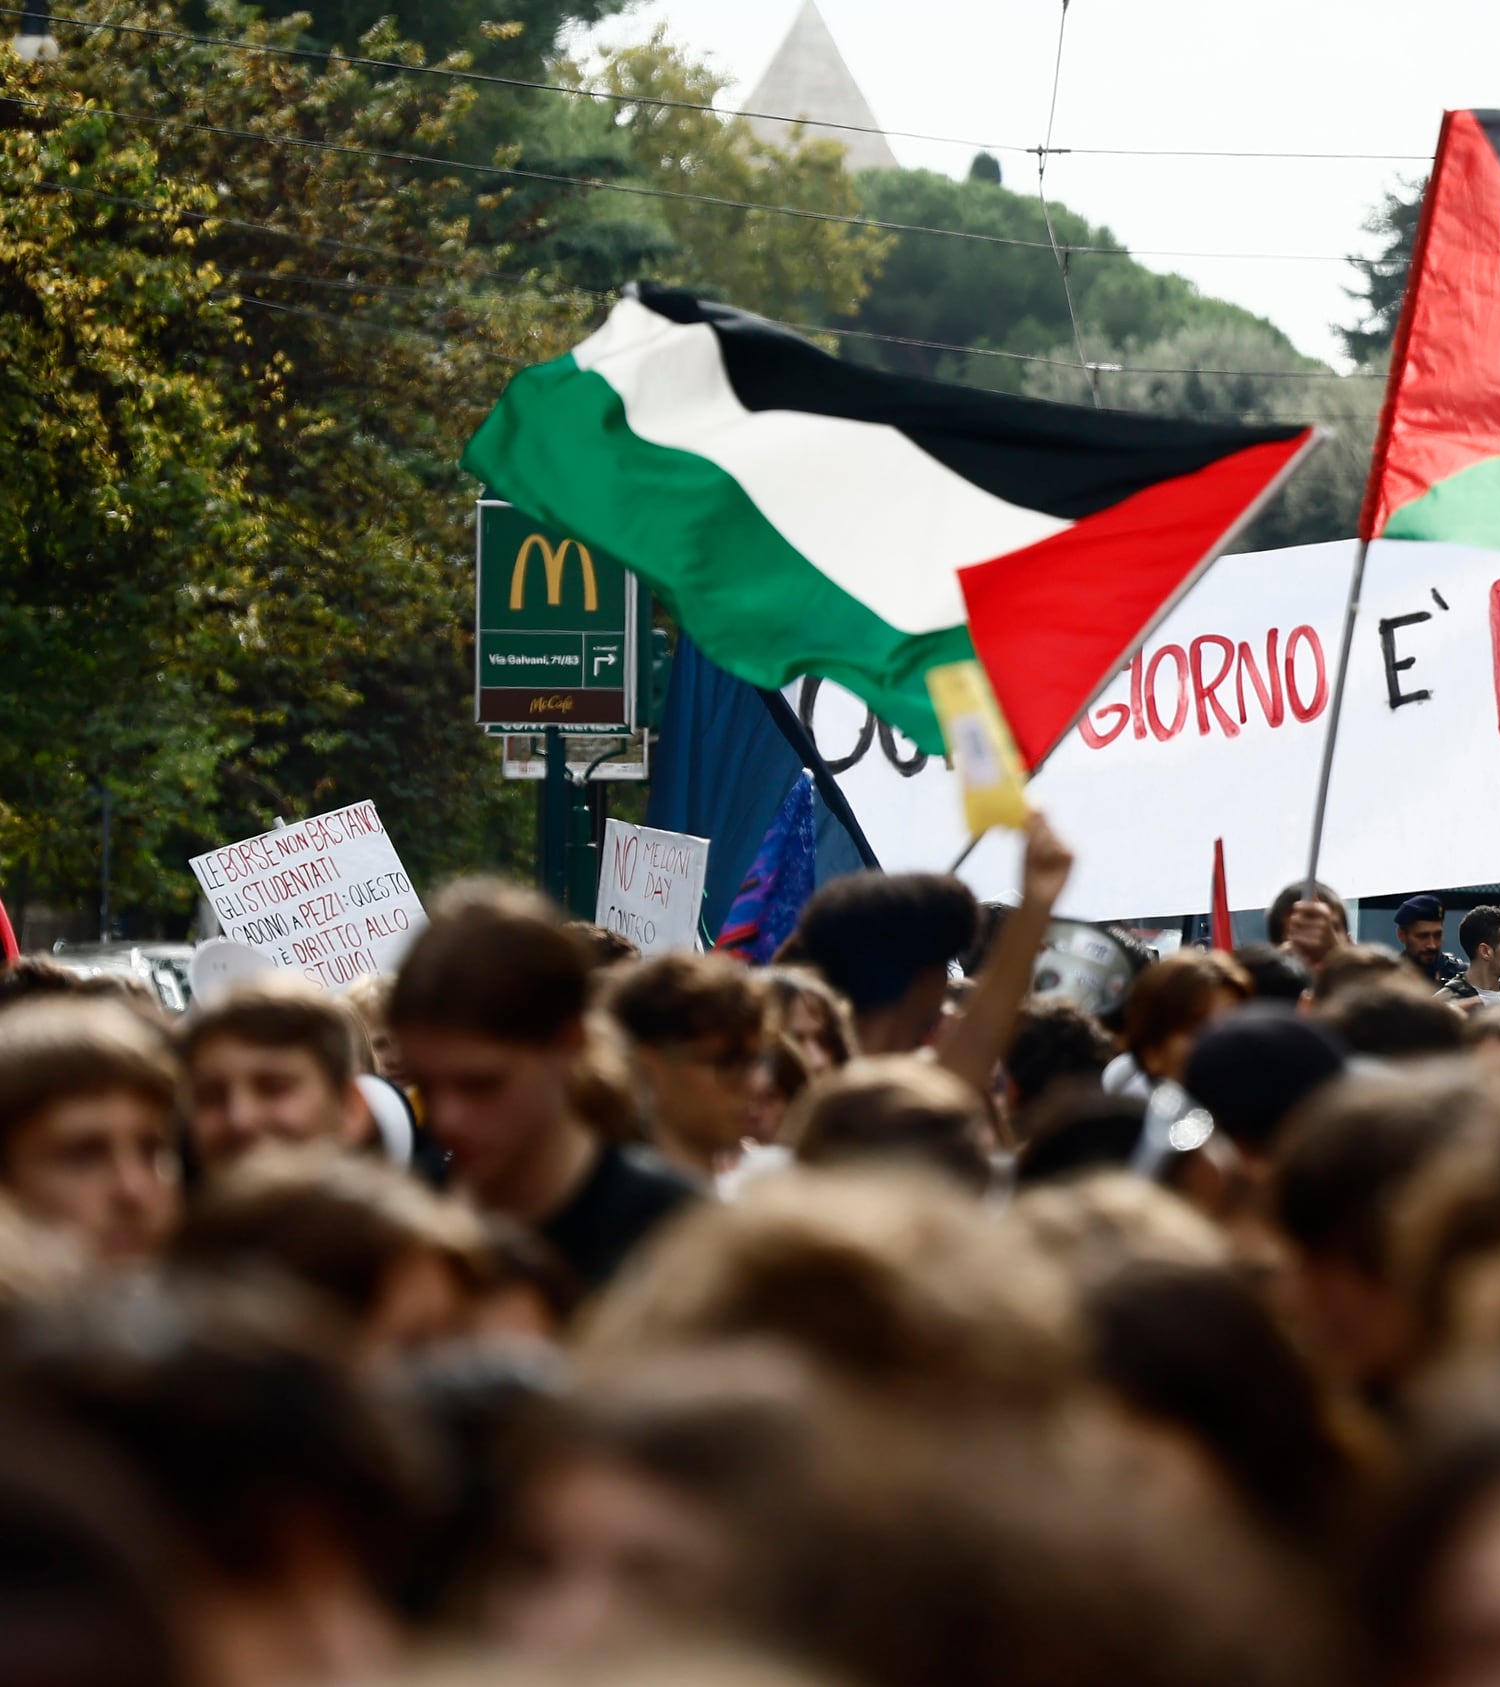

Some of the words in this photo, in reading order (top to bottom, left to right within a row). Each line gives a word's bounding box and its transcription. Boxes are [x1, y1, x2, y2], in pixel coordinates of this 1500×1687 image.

[489, 653, 506, 666] Via
[507, 653, 549, 666] Galvani,
[1077, 624, 1330, 750] GIORNO
[197, 856, 225, 891] LE
[217, 835, 280, 883] BORSE
[275, 834, 310, 858] NON
[304, 804, 384, 852] BASTANO,
[612, 834, 639, 893] NO
[642, 841, 691, 880] MELONI
[216, 893, 248, 921] GLI
[242, 856, 341, 913] STUDENTATI
[231, 913, 290, 945] CADONO
[293, 916, 304, 932] A
[349, 871, 411, 908] QUESTO
[643, 871, 672, 910] DAY
[280, 947, 293, 966] È
[292, 923, 363, 965] DIRITTO
[365, 908, 409, 941] ALLO
[605, 905, 656, 945] CONTRO
[303, 948, 380, 993] STUDIO!
